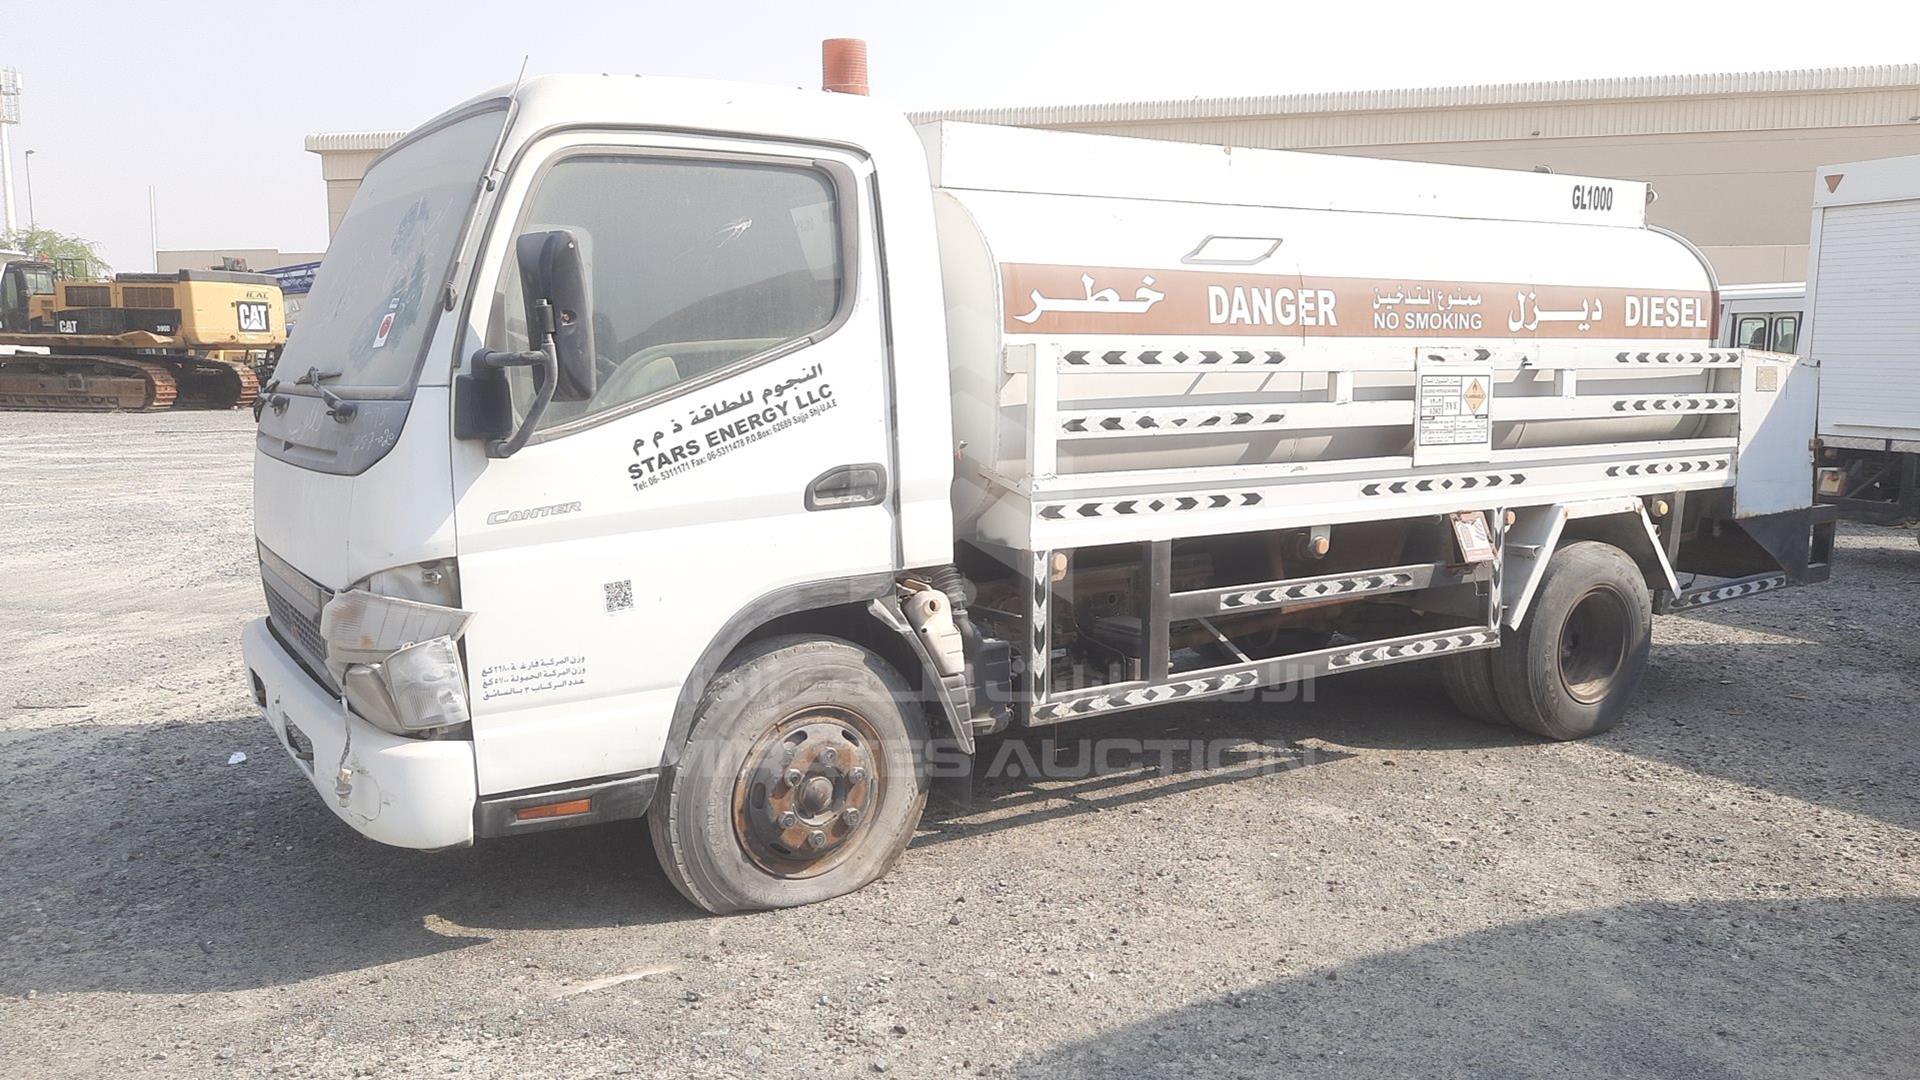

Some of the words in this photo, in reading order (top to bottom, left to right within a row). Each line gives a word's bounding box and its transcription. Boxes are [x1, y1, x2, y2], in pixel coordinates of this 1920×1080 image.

[1572, 184, 1613, 211] GL1000
[1013, 272, 1165, 324] خطر
[1207, 284, 1338, 327] DANGER
[1372, 284, 1435, 310] التدخين
[1437, 286, 1482, 311] ممنوع
[1508, 289, 1602, 332] ديزل
[1624, 295, 1708, 329] DIESEL
[59, 320, 77, 333] CAT
[238, 303, 267, 330] CAT
[1374, 312, 1400, 330] NO
[1404, 312, 1482, 330] SMOKING
[762, 362, 824, 405] النجوم
[690, 389, 754, 426] للطاقة
[627, 439, 701, 480] STARS
[705, 399, 788, 448] ENERGY
[795, 383, 833, 410] LLC
[633, 481, 649, 492] Tel:
[660, 462, 691, 481] 5311171
[691, 456, 707, 468] Fax:
[486, 500, 582, 526] CANTER
